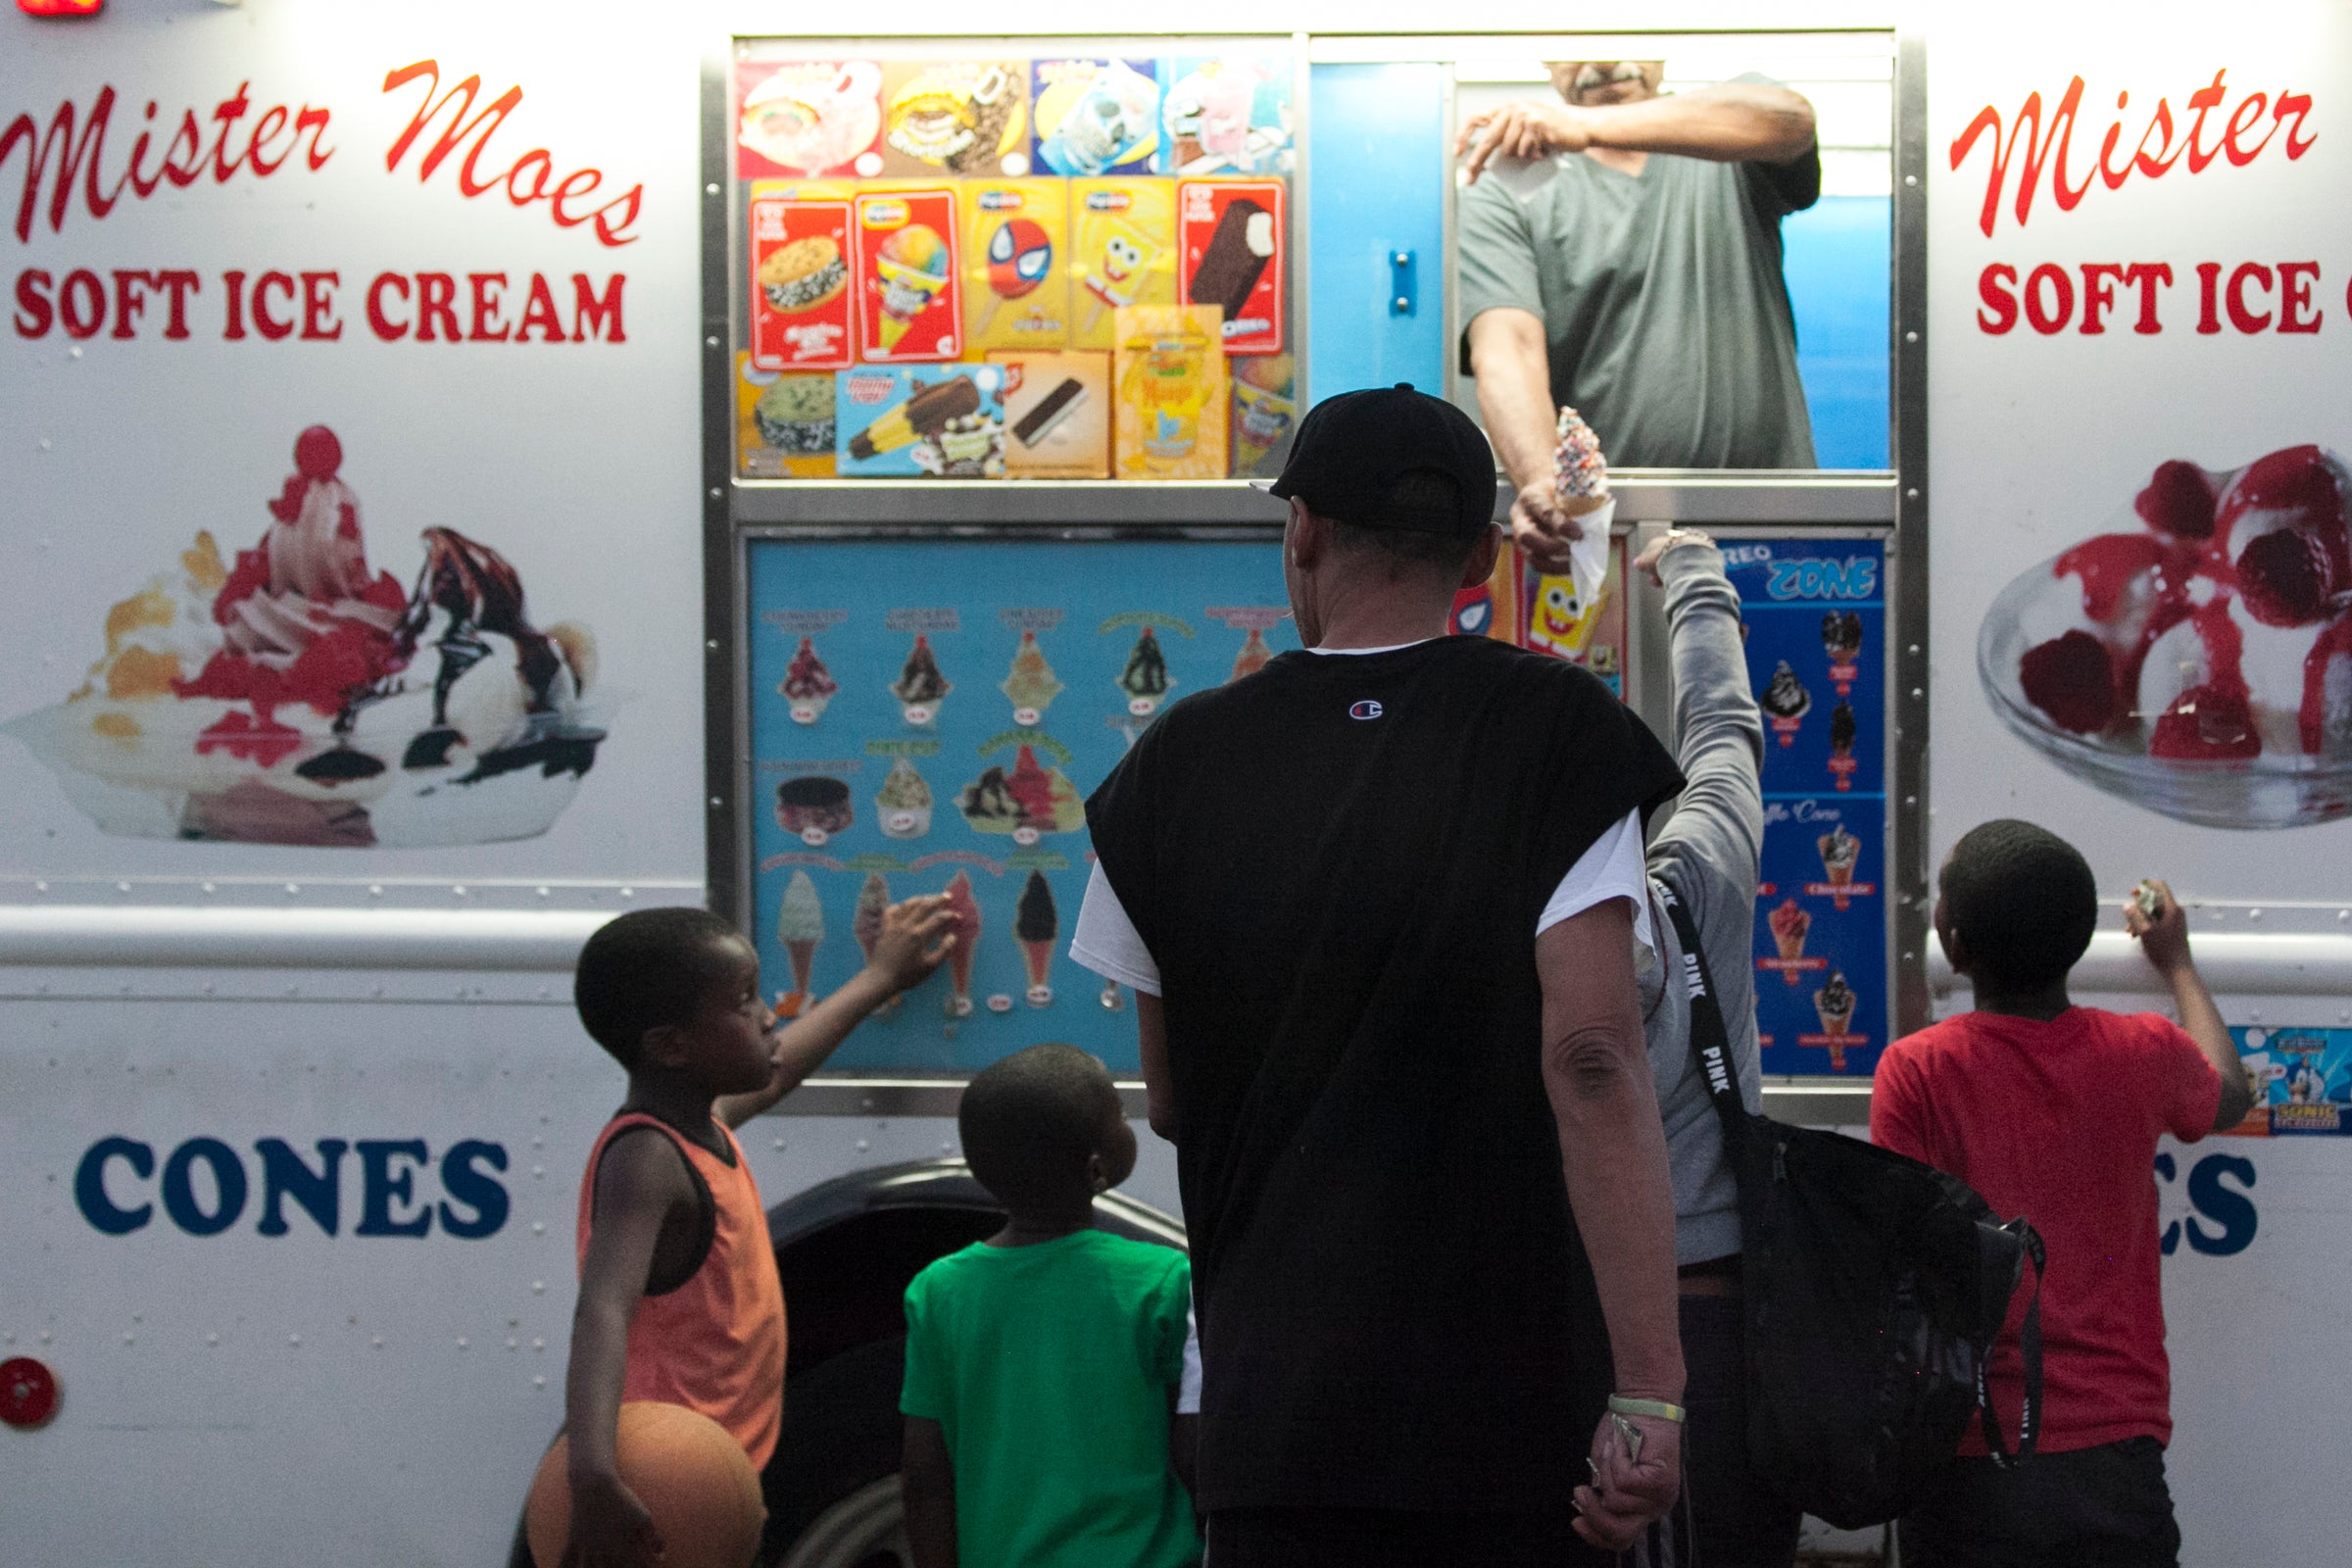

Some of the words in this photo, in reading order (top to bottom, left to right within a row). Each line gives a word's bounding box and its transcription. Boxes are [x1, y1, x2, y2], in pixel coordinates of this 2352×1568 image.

[0, 80, 335, 244] Mister
[382, 59, 643, 247] Moes
[1950, 68, 2318, 238] Mister
[14, 269, 200, 340] SOFT
[222, 270, 343, 340] ICE
[366, 272, 627, 343] CREAM
[1977, 262, 2173, 336] SOFT
[2195, 261, 2324, 336] ICE
[1724, 544, 1772, 565] REO
[1767, 551, 1878, 601] ZONE
[1763, 802, 1790, 826] ffle
[1792, 799, 1841, 823] Cone
[1683, 953, 1707, 1002] PINK
[1702, 1046, 1731, 1095] PINK
[74, 1135, 511, 1240] CONES
